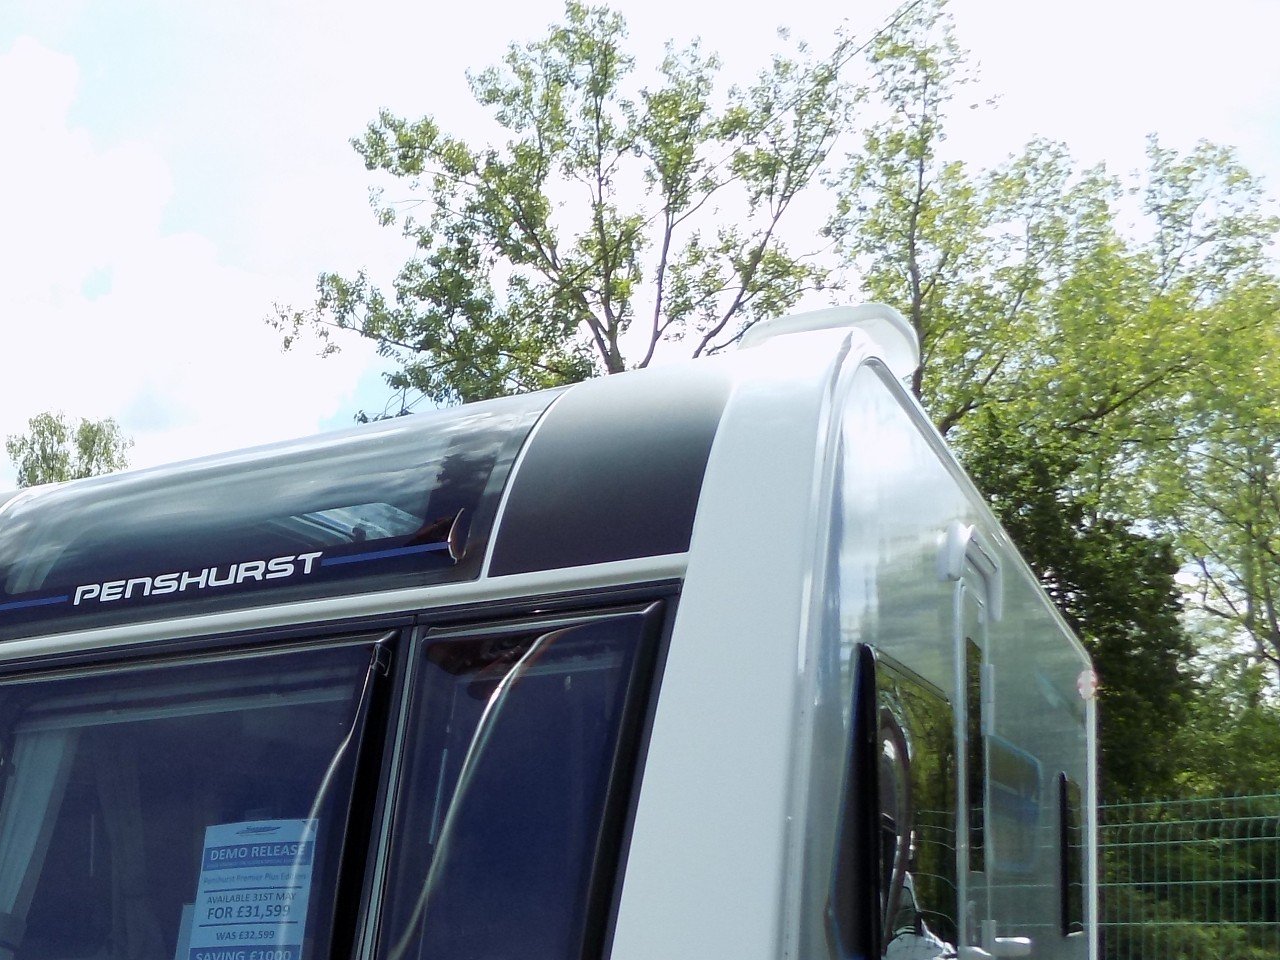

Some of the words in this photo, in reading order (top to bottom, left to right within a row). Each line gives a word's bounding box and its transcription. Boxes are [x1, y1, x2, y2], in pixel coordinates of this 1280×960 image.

[73, 552, 323, 605] PENSHURST
[211, 848, 248, 861] DEMO
[251, 844, 306, 858] RELEASE
[207, 894, 250, 904] AVAILABLE
[253, 893, 274, 902] 31ST
[208, 907, 233, 919] FOR
[237, 904, 291, 919] £31,599
[216, 931, 236, 940] WAS
